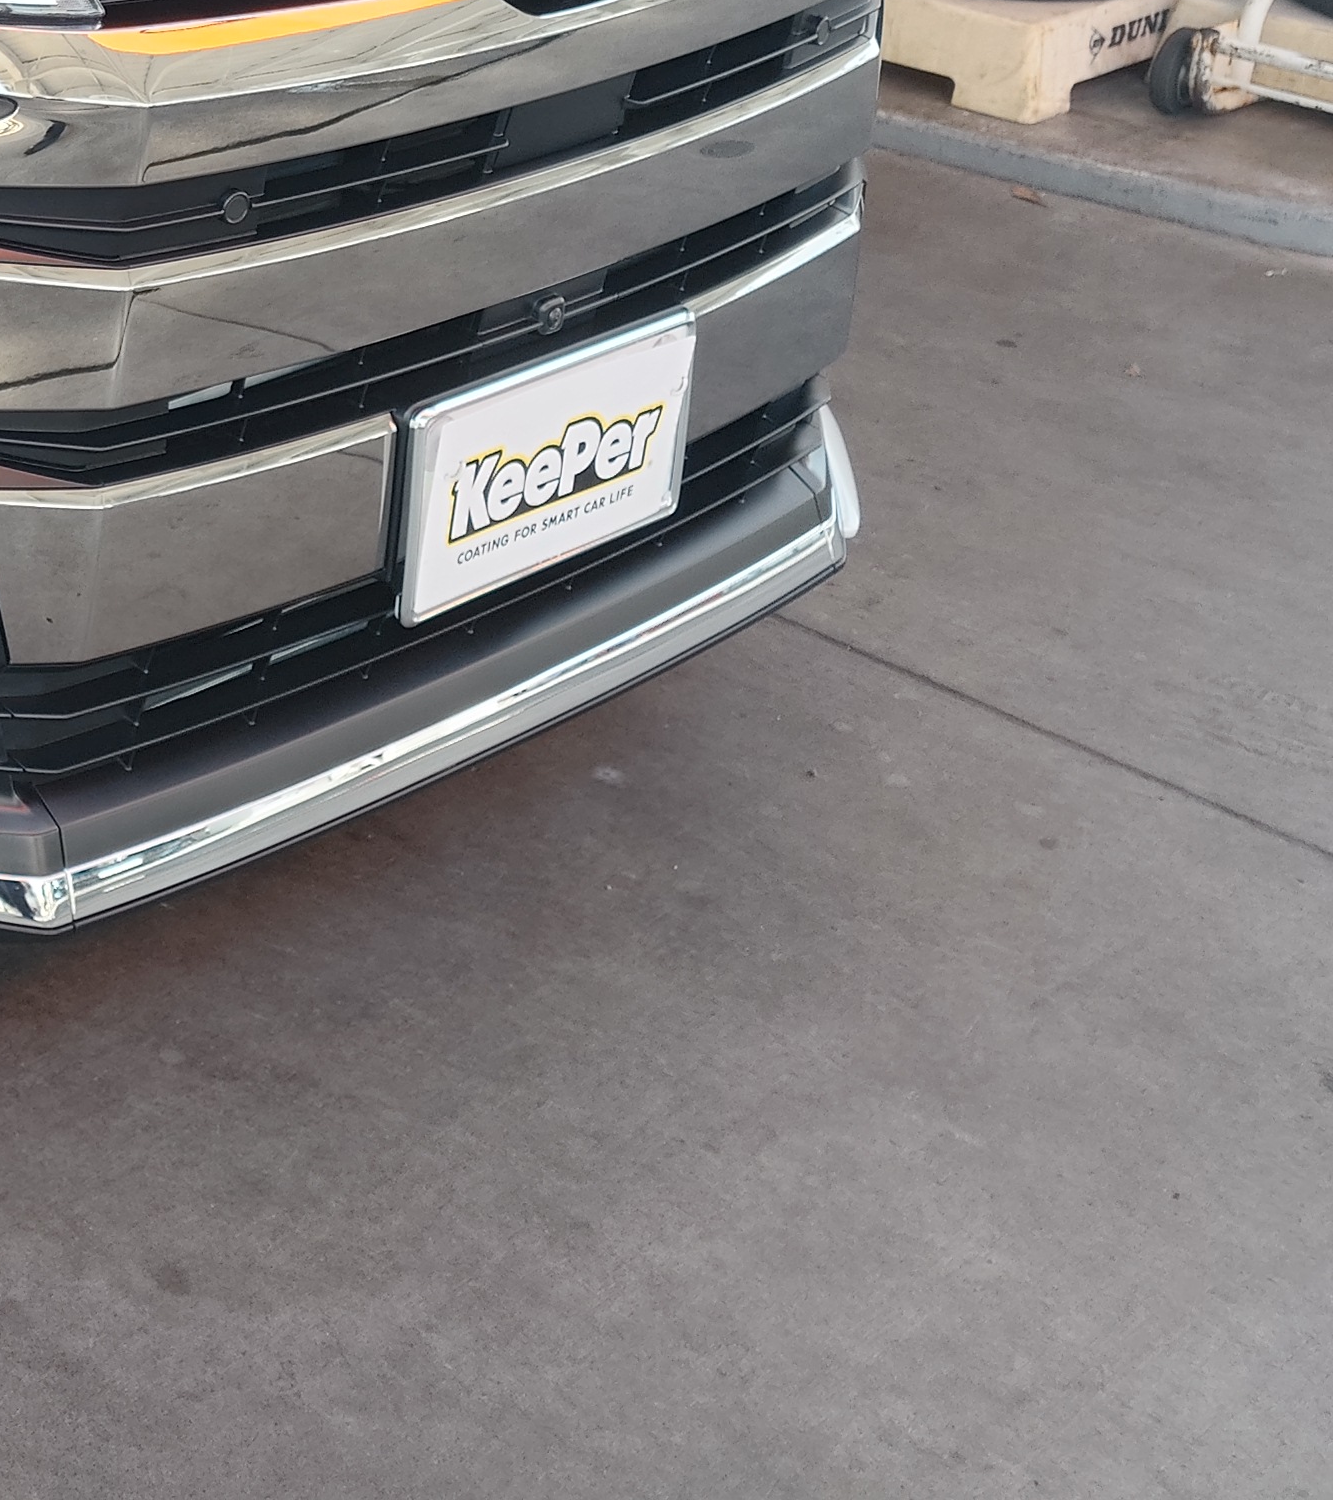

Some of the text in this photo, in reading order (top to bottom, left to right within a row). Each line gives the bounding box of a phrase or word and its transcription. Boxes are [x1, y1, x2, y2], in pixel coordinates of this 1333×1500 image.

[448, 404, 663, 543] KeePer
[457, 484, 635, 565] COATING FOR SMART CAR LIFE
